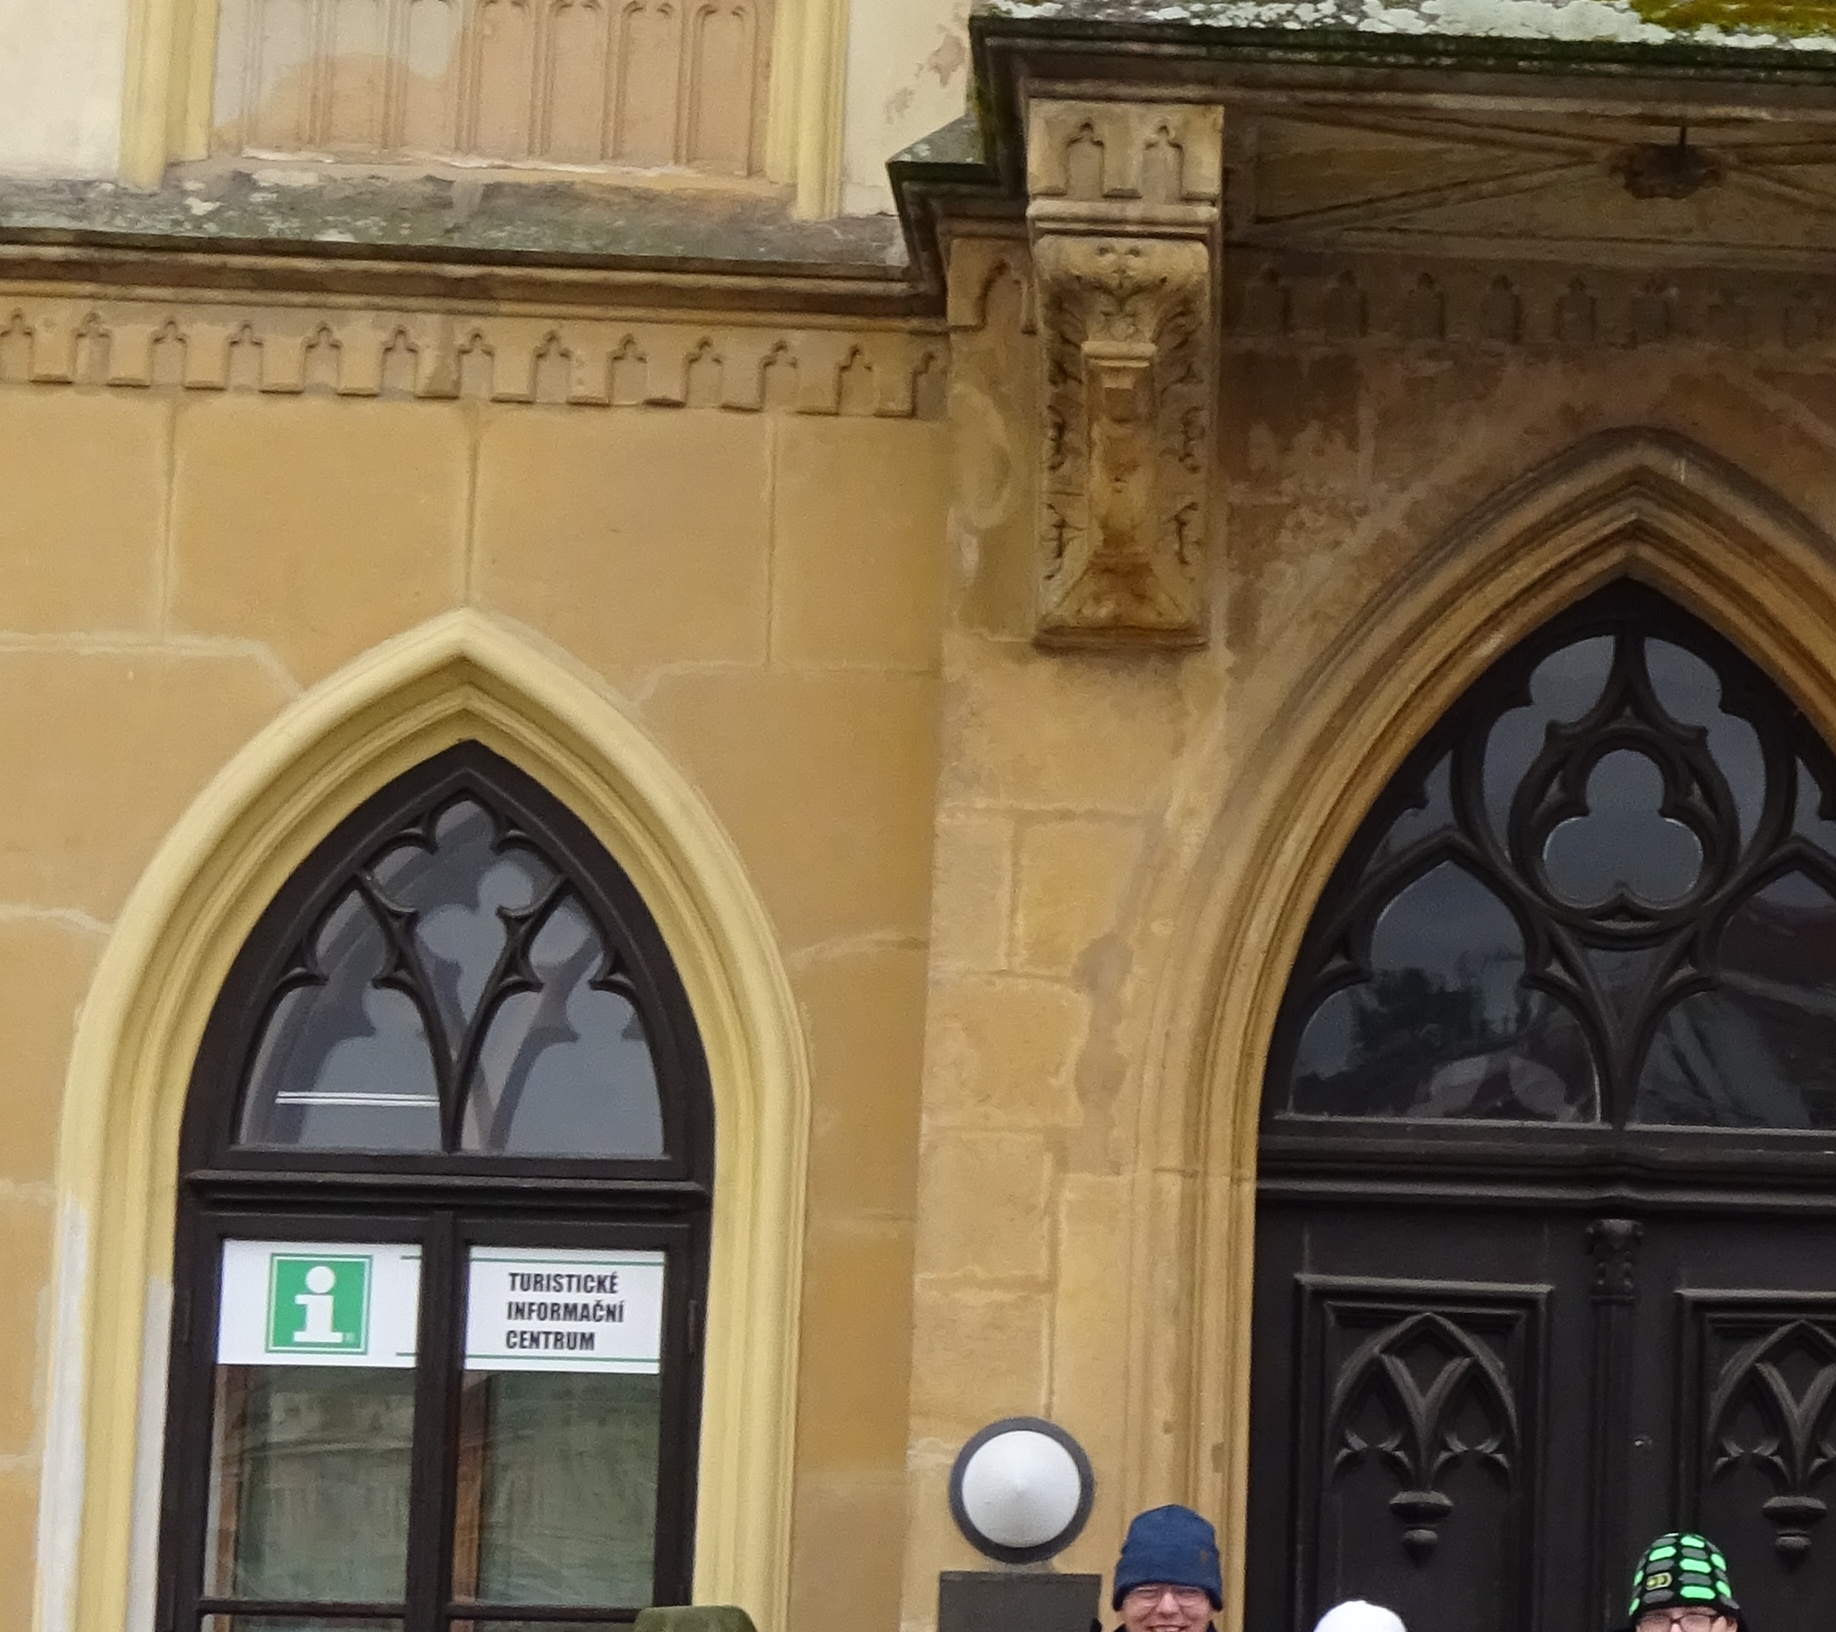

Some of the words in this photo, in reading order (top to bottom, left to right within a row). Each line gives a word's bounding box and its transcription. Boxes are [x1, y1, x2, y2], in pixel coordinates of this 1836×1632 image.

[508, 1271, 620, 1294] TURISTICKÉ
[506, 1300, 626, 1323] INFORMAČNÍ
[505, 1329, 595, 1351] CENTRUM
